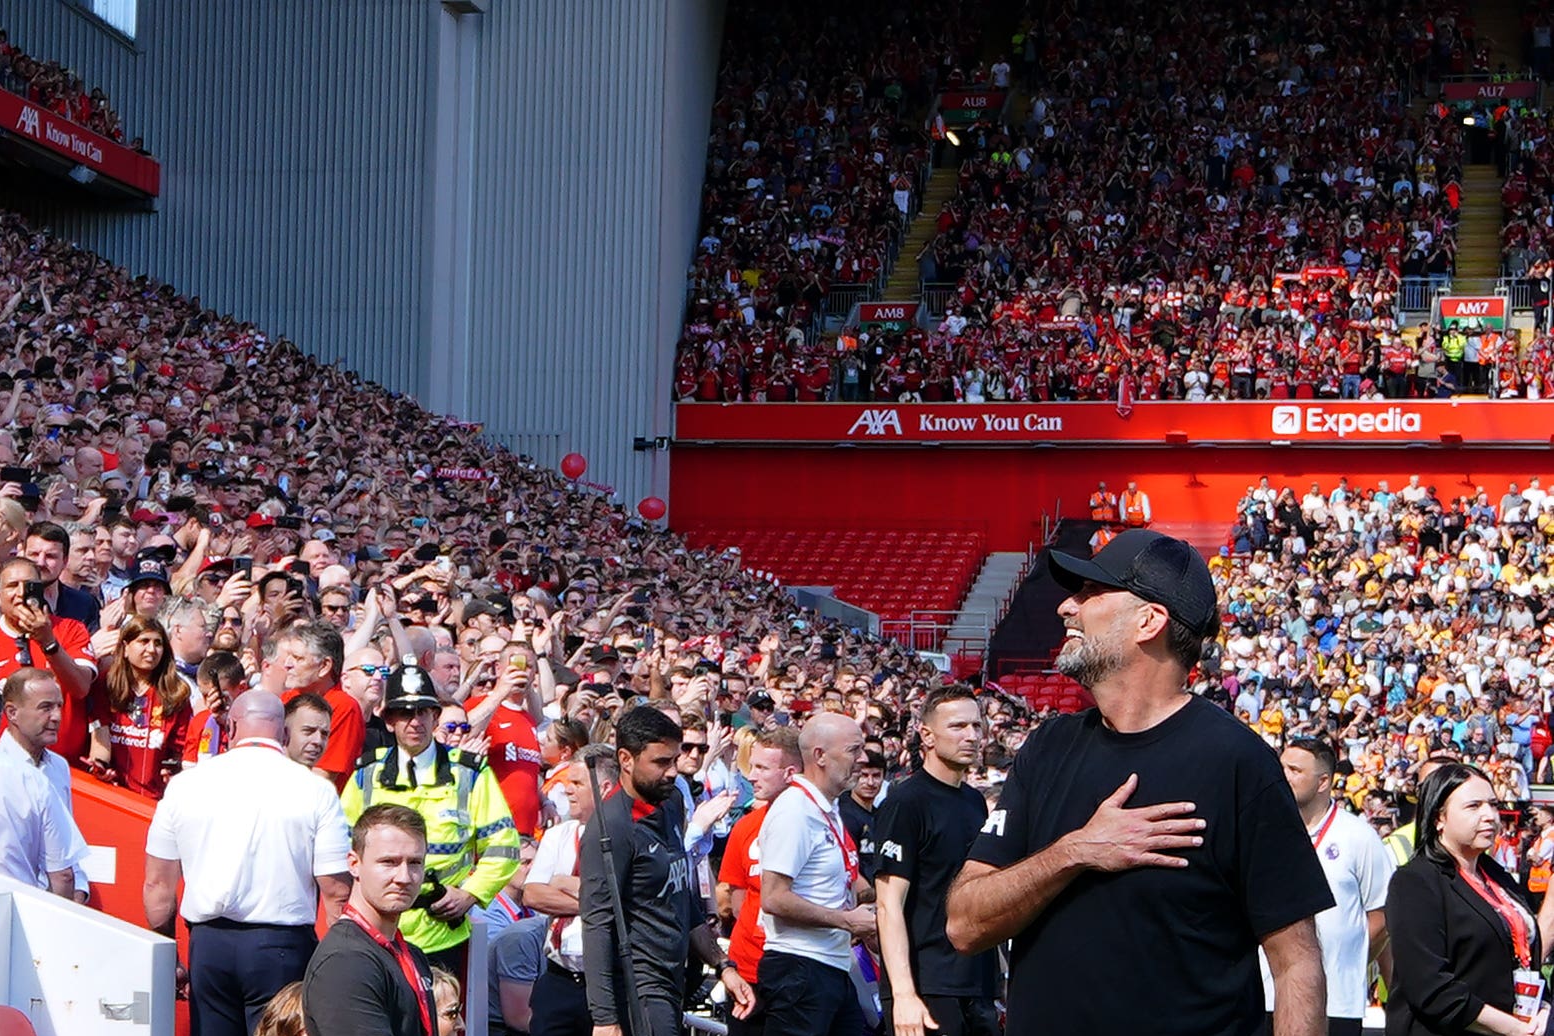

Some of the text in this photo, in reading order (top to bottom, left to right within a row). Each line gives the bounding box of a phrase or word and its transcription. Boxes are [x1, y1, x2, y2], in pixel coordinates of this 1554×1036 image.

[1478, 86, 1505, 97] AU7
[962, 97, 987, 108] AU8
[16, 105, 40, 139] AXA
[46, 121, 102, 163] Know You Can
[874, 308, 905, 319] AM8
[1455, 302, 1489, 314] AM7
[847, 409, 903, 435] AXA
[919, 413, 1062, 431] Know You Can
[1306, 407, 1421, 437] Expedia
[111, 722, 148, 738] tandard
[111, 735, 148, 748] artered
